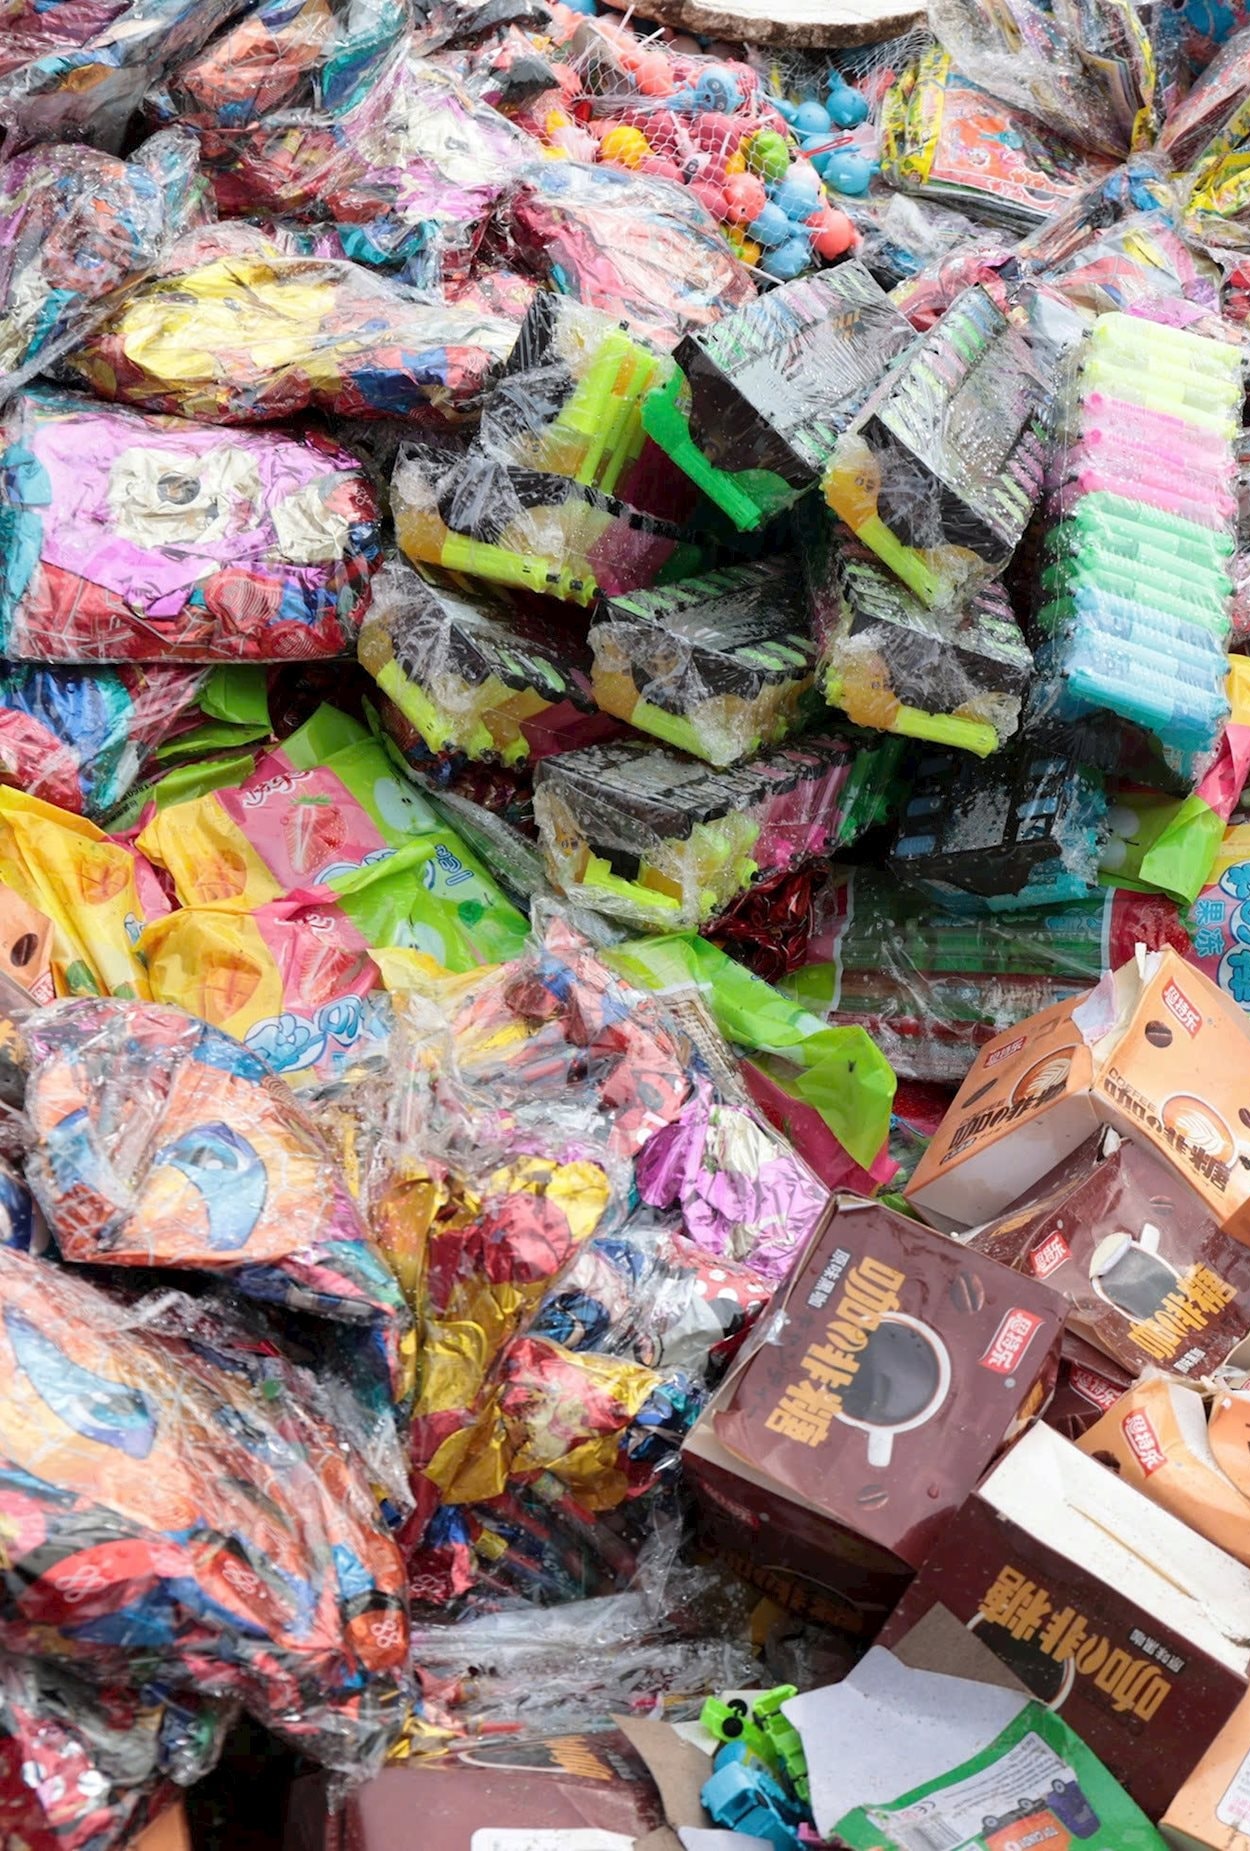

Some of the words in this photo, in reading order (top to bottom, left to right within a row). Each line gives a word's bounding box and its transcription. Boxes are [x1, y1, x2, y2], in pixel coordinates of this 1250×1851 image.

[1195, 900, 1226, 957] 果冻
[1166, 985, 1200, 1033] 思特乐
[1109, 1067, 1156, 1111] COFFEE
[1104, 1078, 1231, 1194] 咖啡糖
[810, 1250, 851, 1307] 原味黑咖
[1034, 1237, 1067, 1273] 思特乐
[1128, 1263, 1238, 1360] 咖啡糖
[766, 1256, 905, 1447] 咖啡糖
[988, 1312, 1034, 1371] 思特乐
[1126, 1413, 1163, 1470] 思特乐
[979, 1565, 1171, 1721] 咖啡糖
[1130, 1629, 1184, 1671] 原味黑咖
